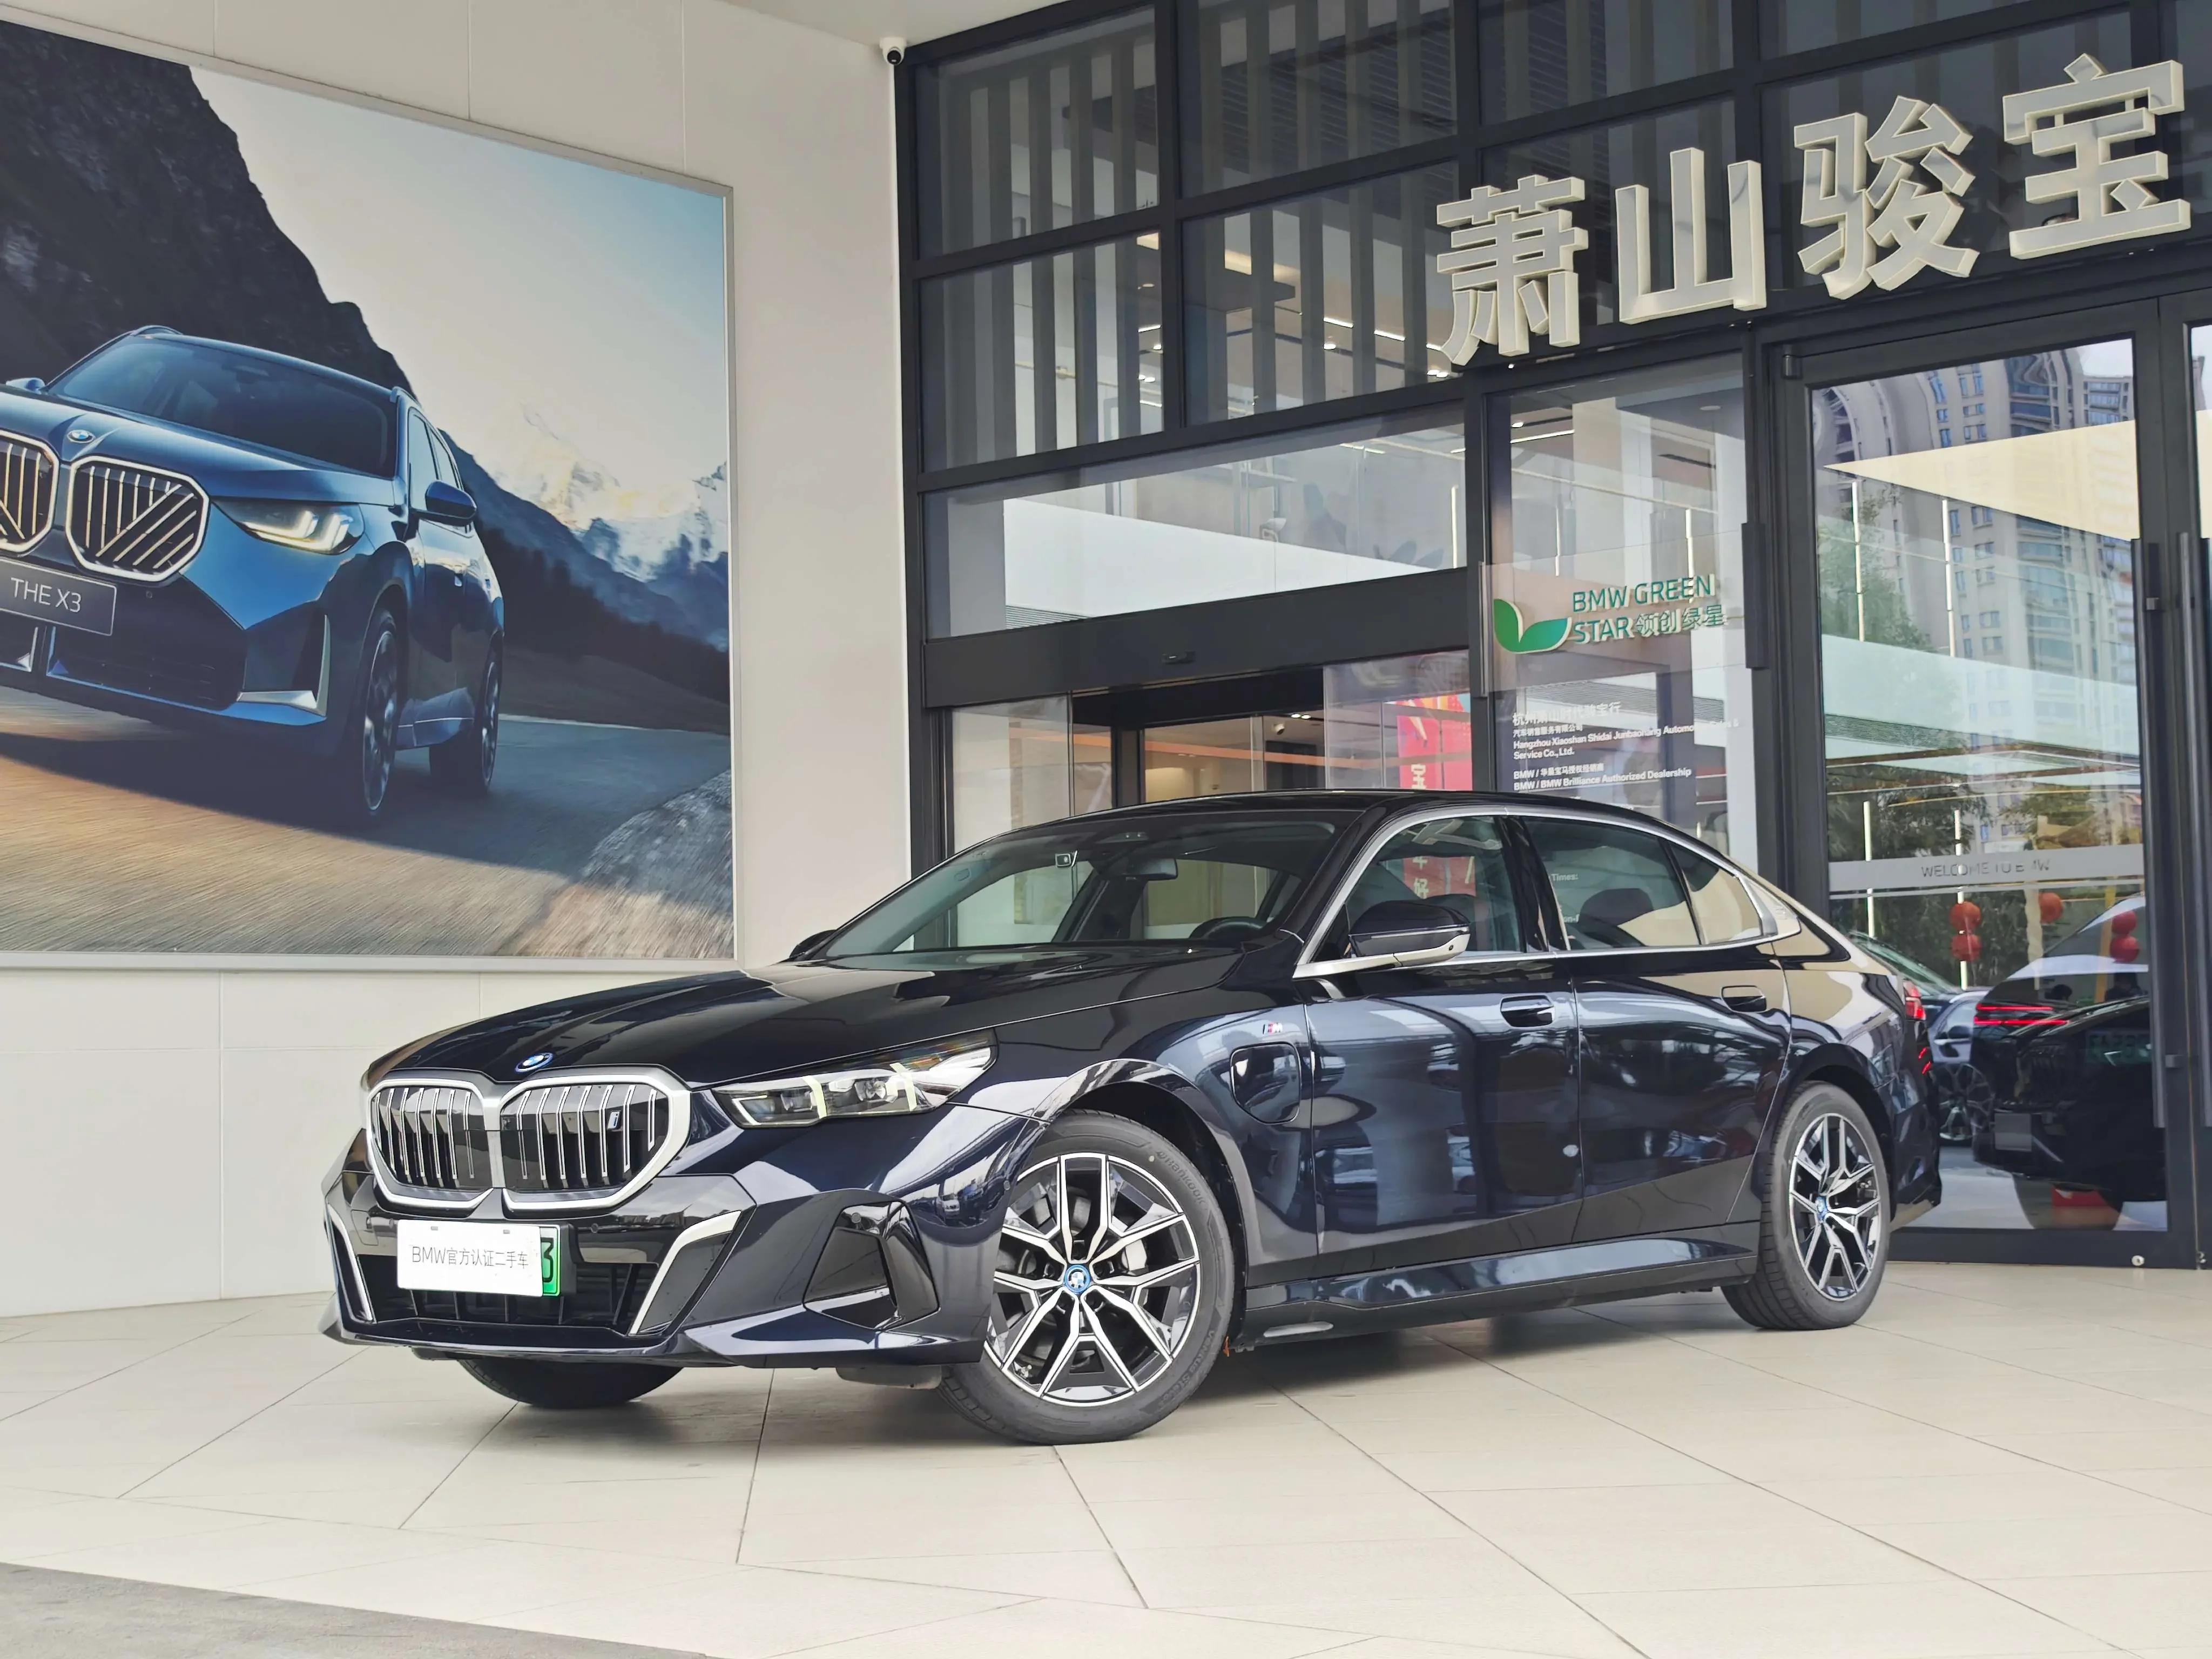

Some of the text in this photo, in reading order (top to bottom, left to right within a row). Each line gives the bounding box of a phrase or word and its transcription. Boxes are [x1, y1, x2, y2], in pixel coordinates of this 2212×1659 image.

[1435, 52, 2191, 366] 萧山骏宝
[11, 577, 82, 612] THE X3
[1573, 574, 1716, 613] BMW GREEN
[1573, 604, 1728, 644] STAR 领创绿星
[1514, 740, 1552, 750] Hangzhou
[1588, 731, 1612, 743] Shidai
[1514, 750, 1543, 760] Service
[1559, 747, 1575, 756] Ltd.
[1514, 769, 1534, 779] BMW
[1514, 781, 1534, 791] BMW
[1540, 778, 1562, 788] BMW
[1602, 771, 1646, 783] Authorized
[1647, 767, 1692, 781] Dealership
[412, 1245, 529, 1269] BMW官方认证二手车
